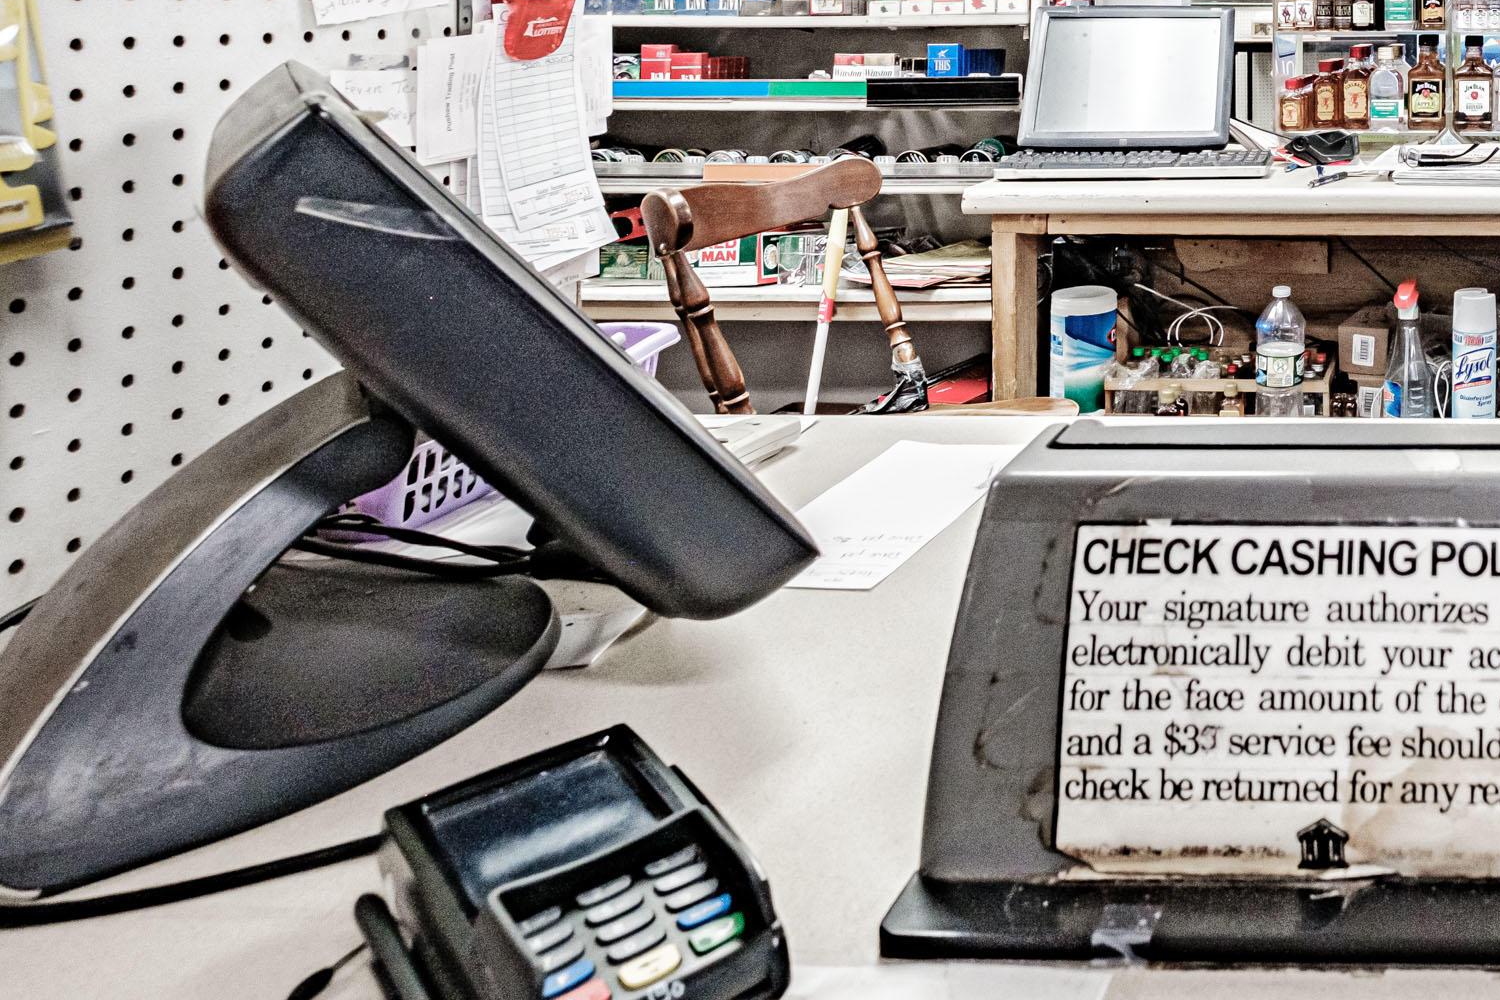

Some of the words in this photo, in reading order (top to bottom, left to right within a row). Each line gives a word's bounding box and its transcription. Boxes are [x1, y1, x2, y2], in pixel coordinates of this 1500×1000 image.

[445, 71, 455, 101] Trading
[834, 69, 862, 78] Winston
[865, 69, 893, 78] Winston
[701, 250, 737, 262] MAN
[1456, 351, 1492, 382] Lysol
[1083, 538, 1220, 575] CHECK
[1231, 538, 1417, 577] CASHING
[1078, 590, 1147, 622] Your
[1163, 590, 1310, 629] signature
[1327, 591, 1489, 625] authorizes
[1071, 634, 1271, 674] electronically
[1287, 634, 1366, 668] debit
[1381, 645, 1453, 676] your
[1070, 678, 1110, 712] for
[1122, 678, 1172, 712] the
[1185, 678, 1244, 712] face
[1258, 682, 1383, 713] amount
[1394, 680, 1427, 714] of
[1436, 680, 1486, 715] the
[1066, 723, 1122, 756] and
[1133, 733, 1152, 756] a
[1228, 724, 1336, 757] service
[1348, 725, 1392, 758] fee
[1065, 768, 1151, 801] check
[1159, 768, 1194, 801] be
[1201, 769, 1338, 803] returned
[1349, 769, 1393, 804] for
[1400, 781, 1459, 813] any
